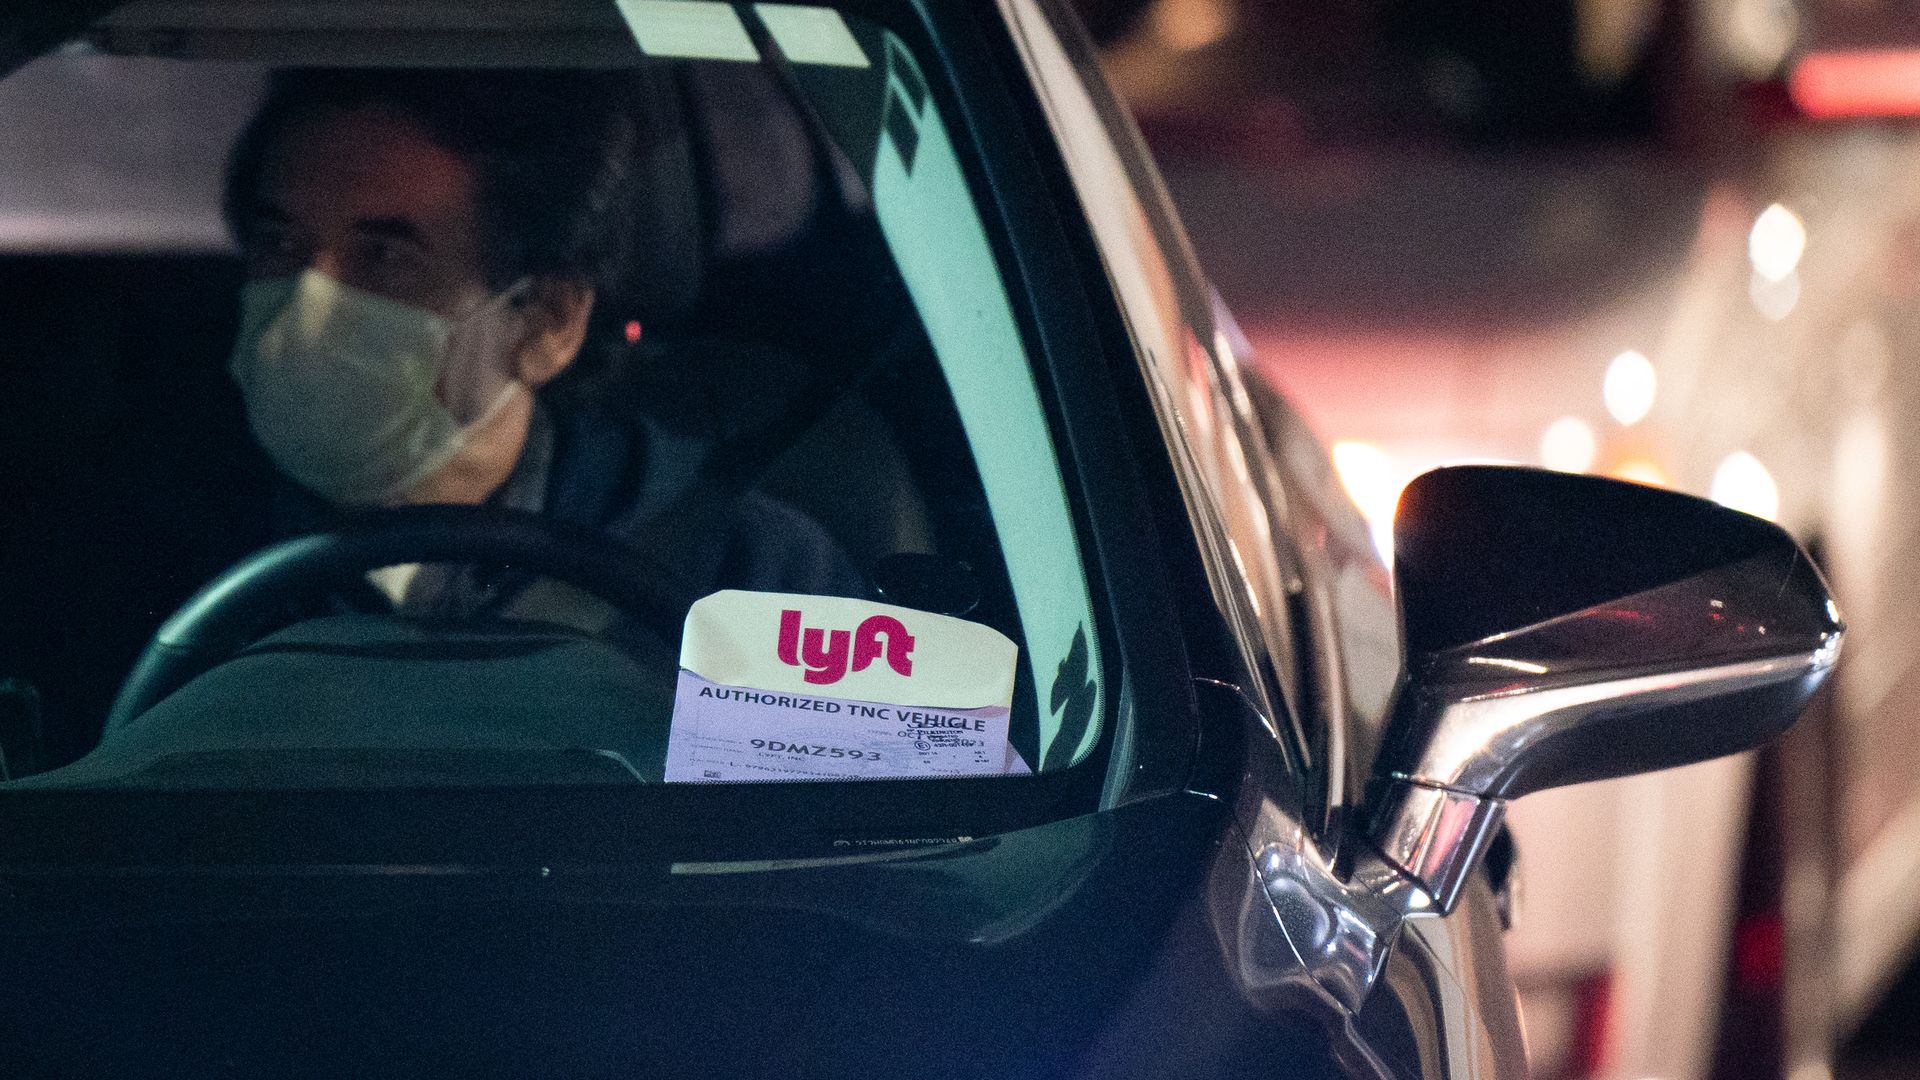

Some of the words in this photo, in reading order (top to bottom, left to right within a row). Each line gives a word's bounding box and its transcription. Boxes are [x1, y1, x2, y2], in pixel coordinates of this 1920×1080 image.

[778, 609, 915, 685] lyft
[698, 686, 841, 713] AUTHORIZED
[846, 704, 891, 721] TNC
[896, 710, 986, 733] VEHICLE
[750, 739, 881, 762] 9DMZ593
